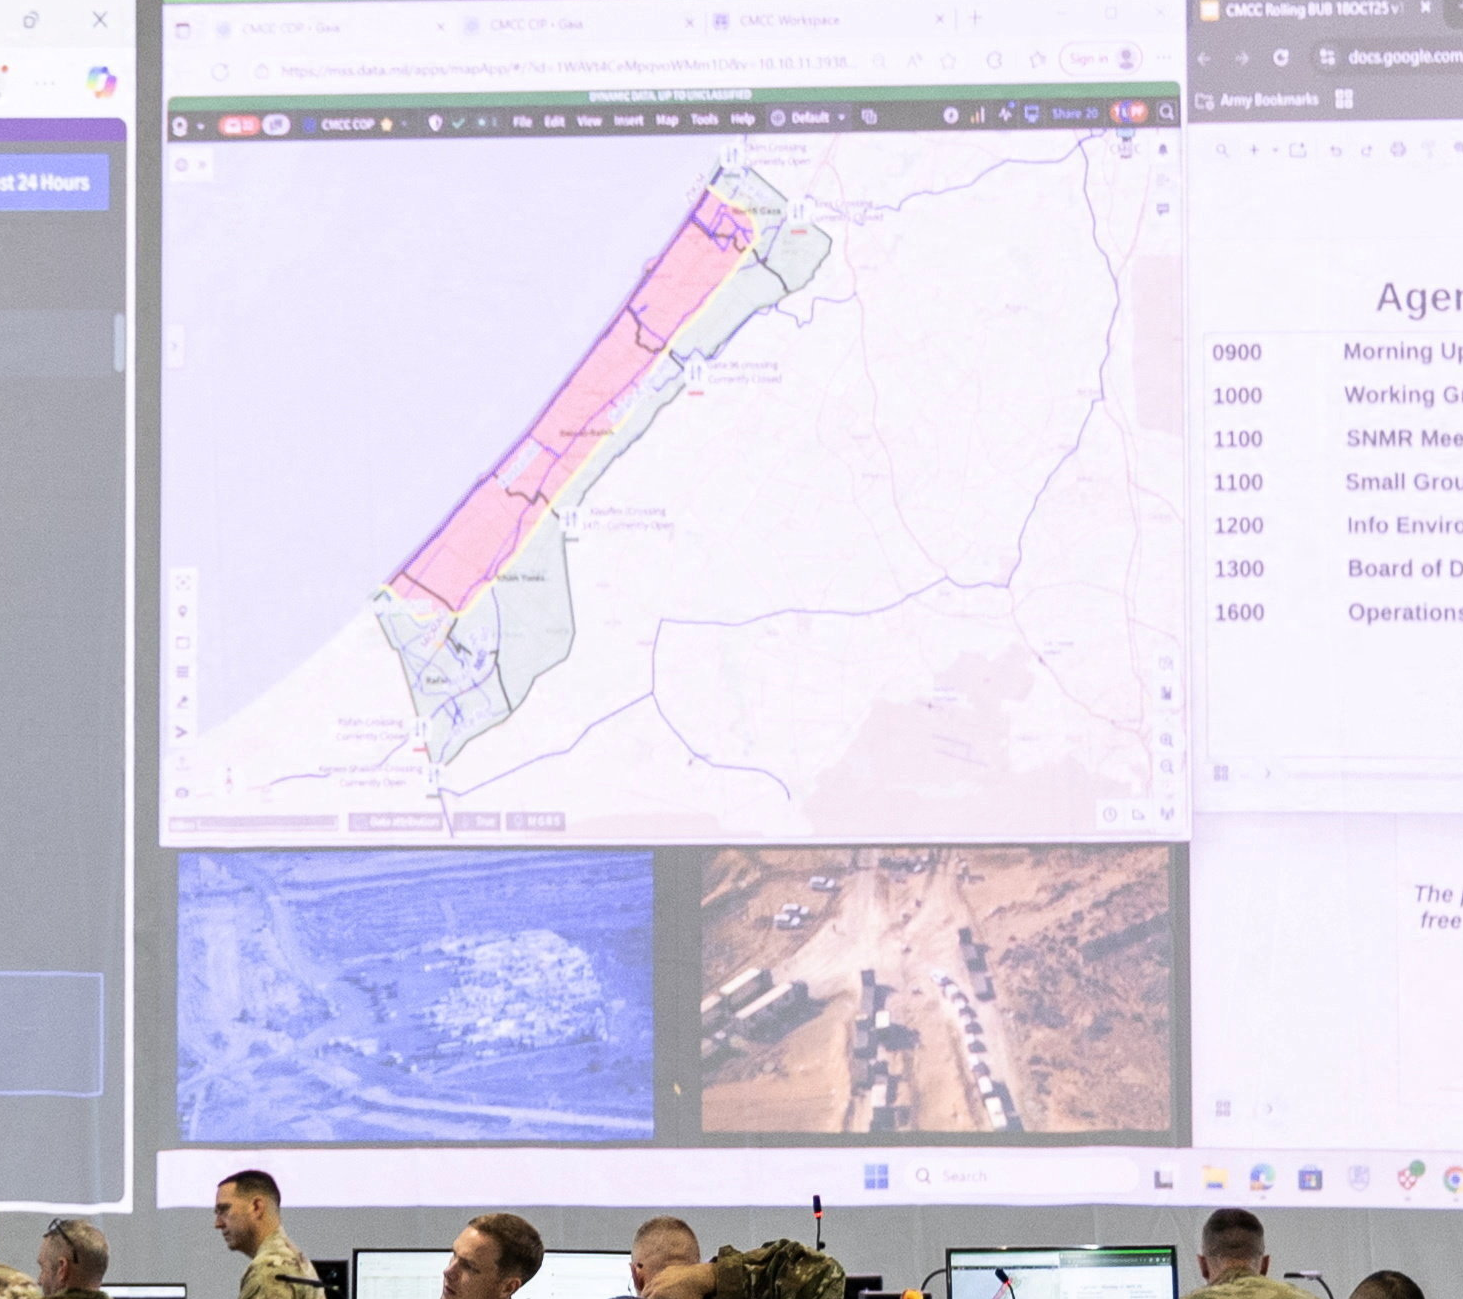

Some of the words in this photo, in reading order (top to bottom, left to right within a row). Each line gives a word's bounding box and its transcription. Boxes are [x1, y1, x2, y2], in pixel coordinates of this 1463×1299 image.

[17, 172, 39, 192] 24
[39, 173, 91, 192] Hours
[1212, 343, 1263, 362] 0900
[1343, 342, 1433, 365] Morning
[1214, 386, 1263, 405] 1000
[1344, 385, 1435, 409] Working
[1215, 430, 1263, 449] 1100
[1347, 429, 1413, 448] SNMR
[1215, 473, 1264, 492] 1100
[1346, 472, 1406, 491] Small
[1215, 516, 1264, 535] 1200
[1347, 515, 1389, 534] Info
[1216, 559, 1265, 579] 1300
[1348, 558, 1413, 578] Board
[1421, 558, 1442, 578] of
[1216, 603, 1265, 622] 1600
[1415, 884, 1454, 903] The
[1420, 910, 1462, 929] free
[942, 1169, 988, 1183] Search
